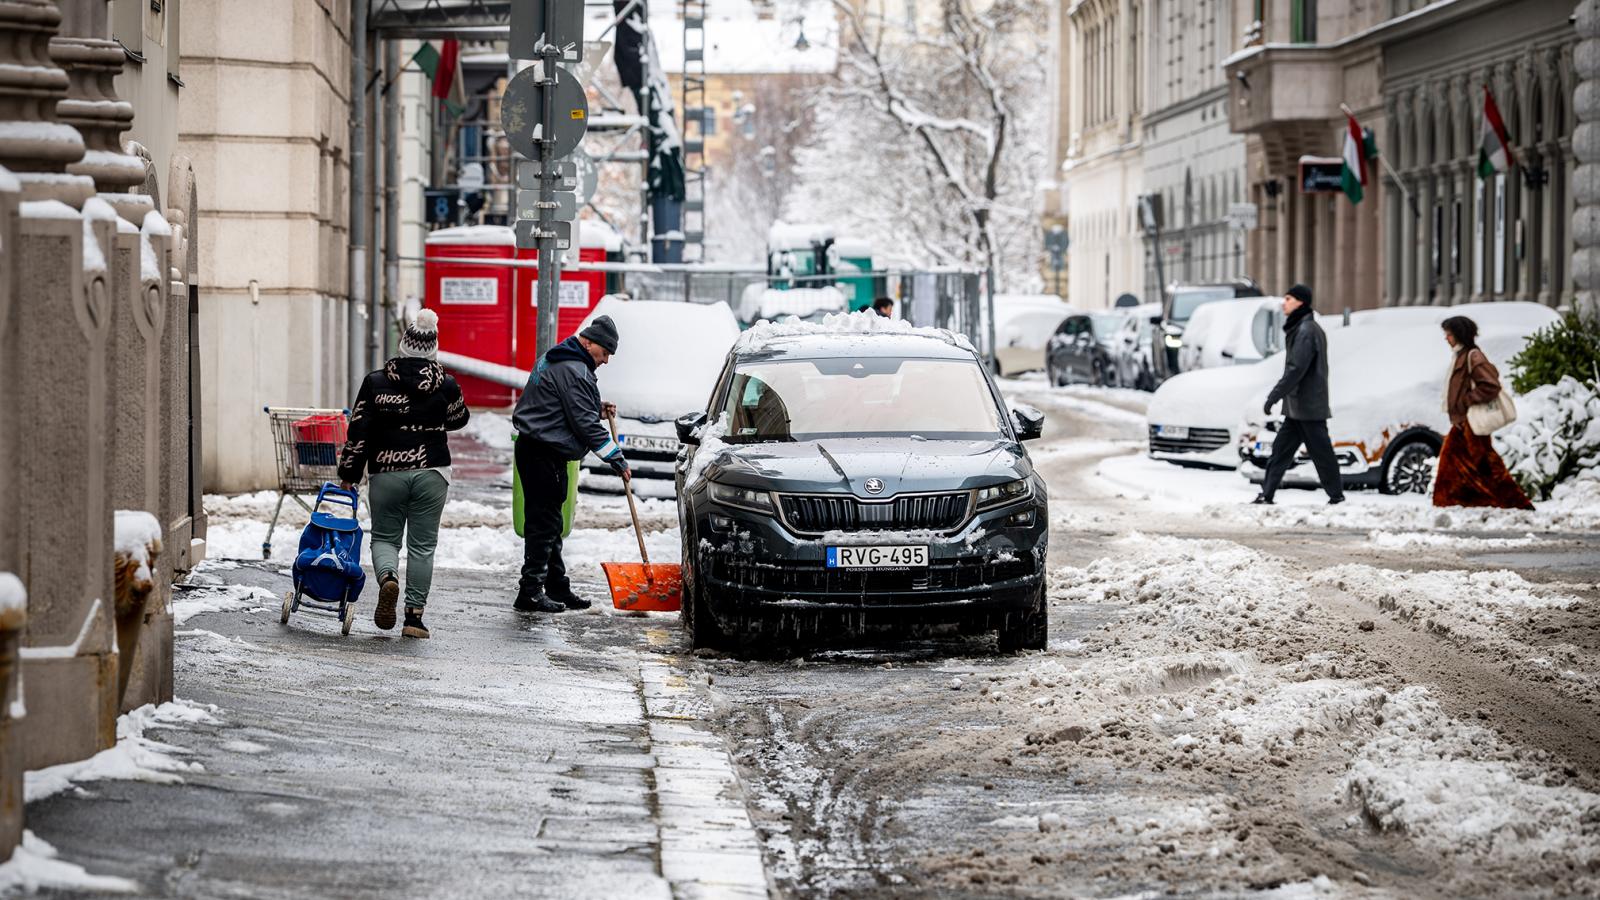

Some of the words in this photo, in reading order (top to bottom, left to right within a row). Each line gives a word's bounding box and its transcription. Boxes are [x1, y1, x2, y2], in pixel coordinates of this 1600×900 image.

[375, 394, 409, 404] CHOOSE
[376, 444, 427, 463] CHOOSE
[841, 548, 924, 565] RVG-495
